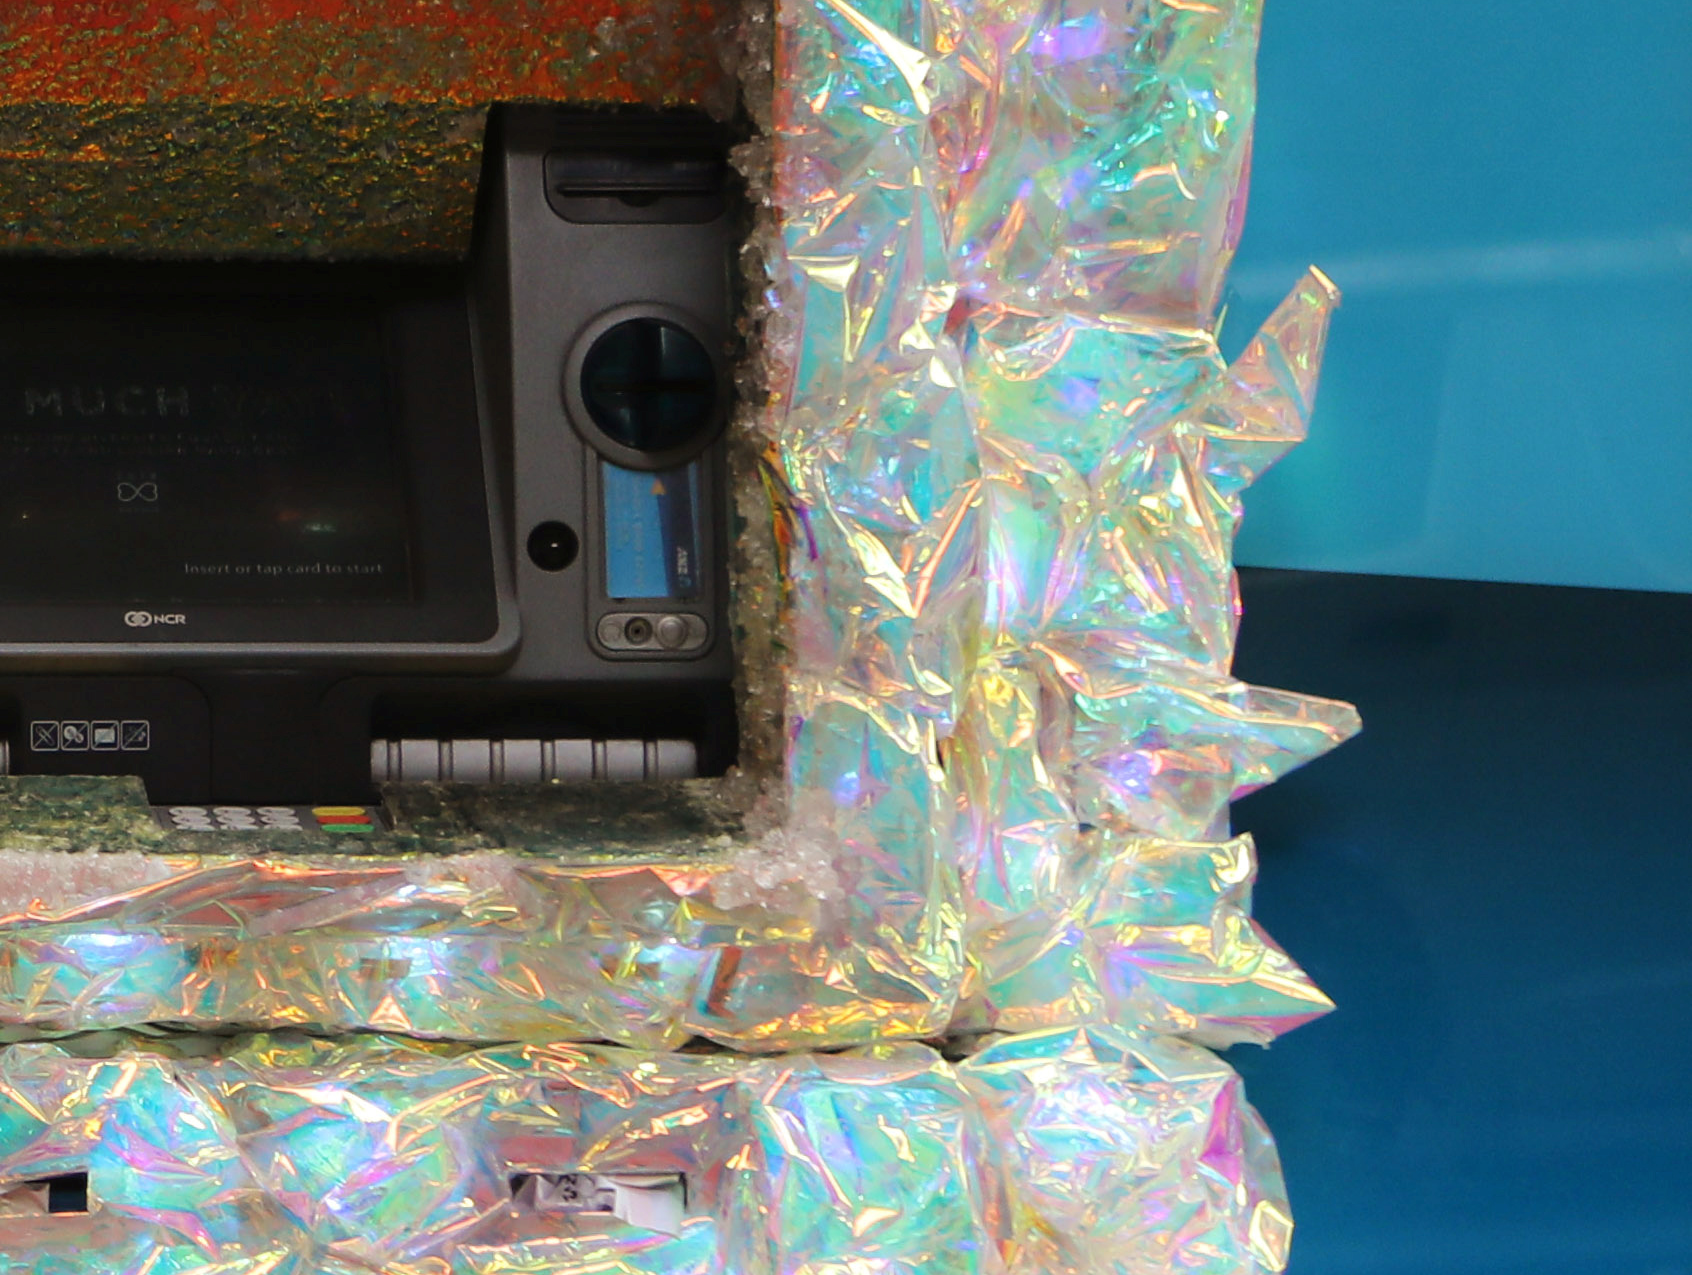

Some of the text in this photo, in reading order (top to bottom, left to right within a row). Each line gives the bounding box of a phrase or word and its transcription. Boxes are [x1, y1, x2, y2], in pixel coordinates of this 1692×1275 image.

[23, 384, 191, 417] MUCH
[184, 563, 384, 576] Insert or tap card to start
[154, 613, 186, 625] NCR
